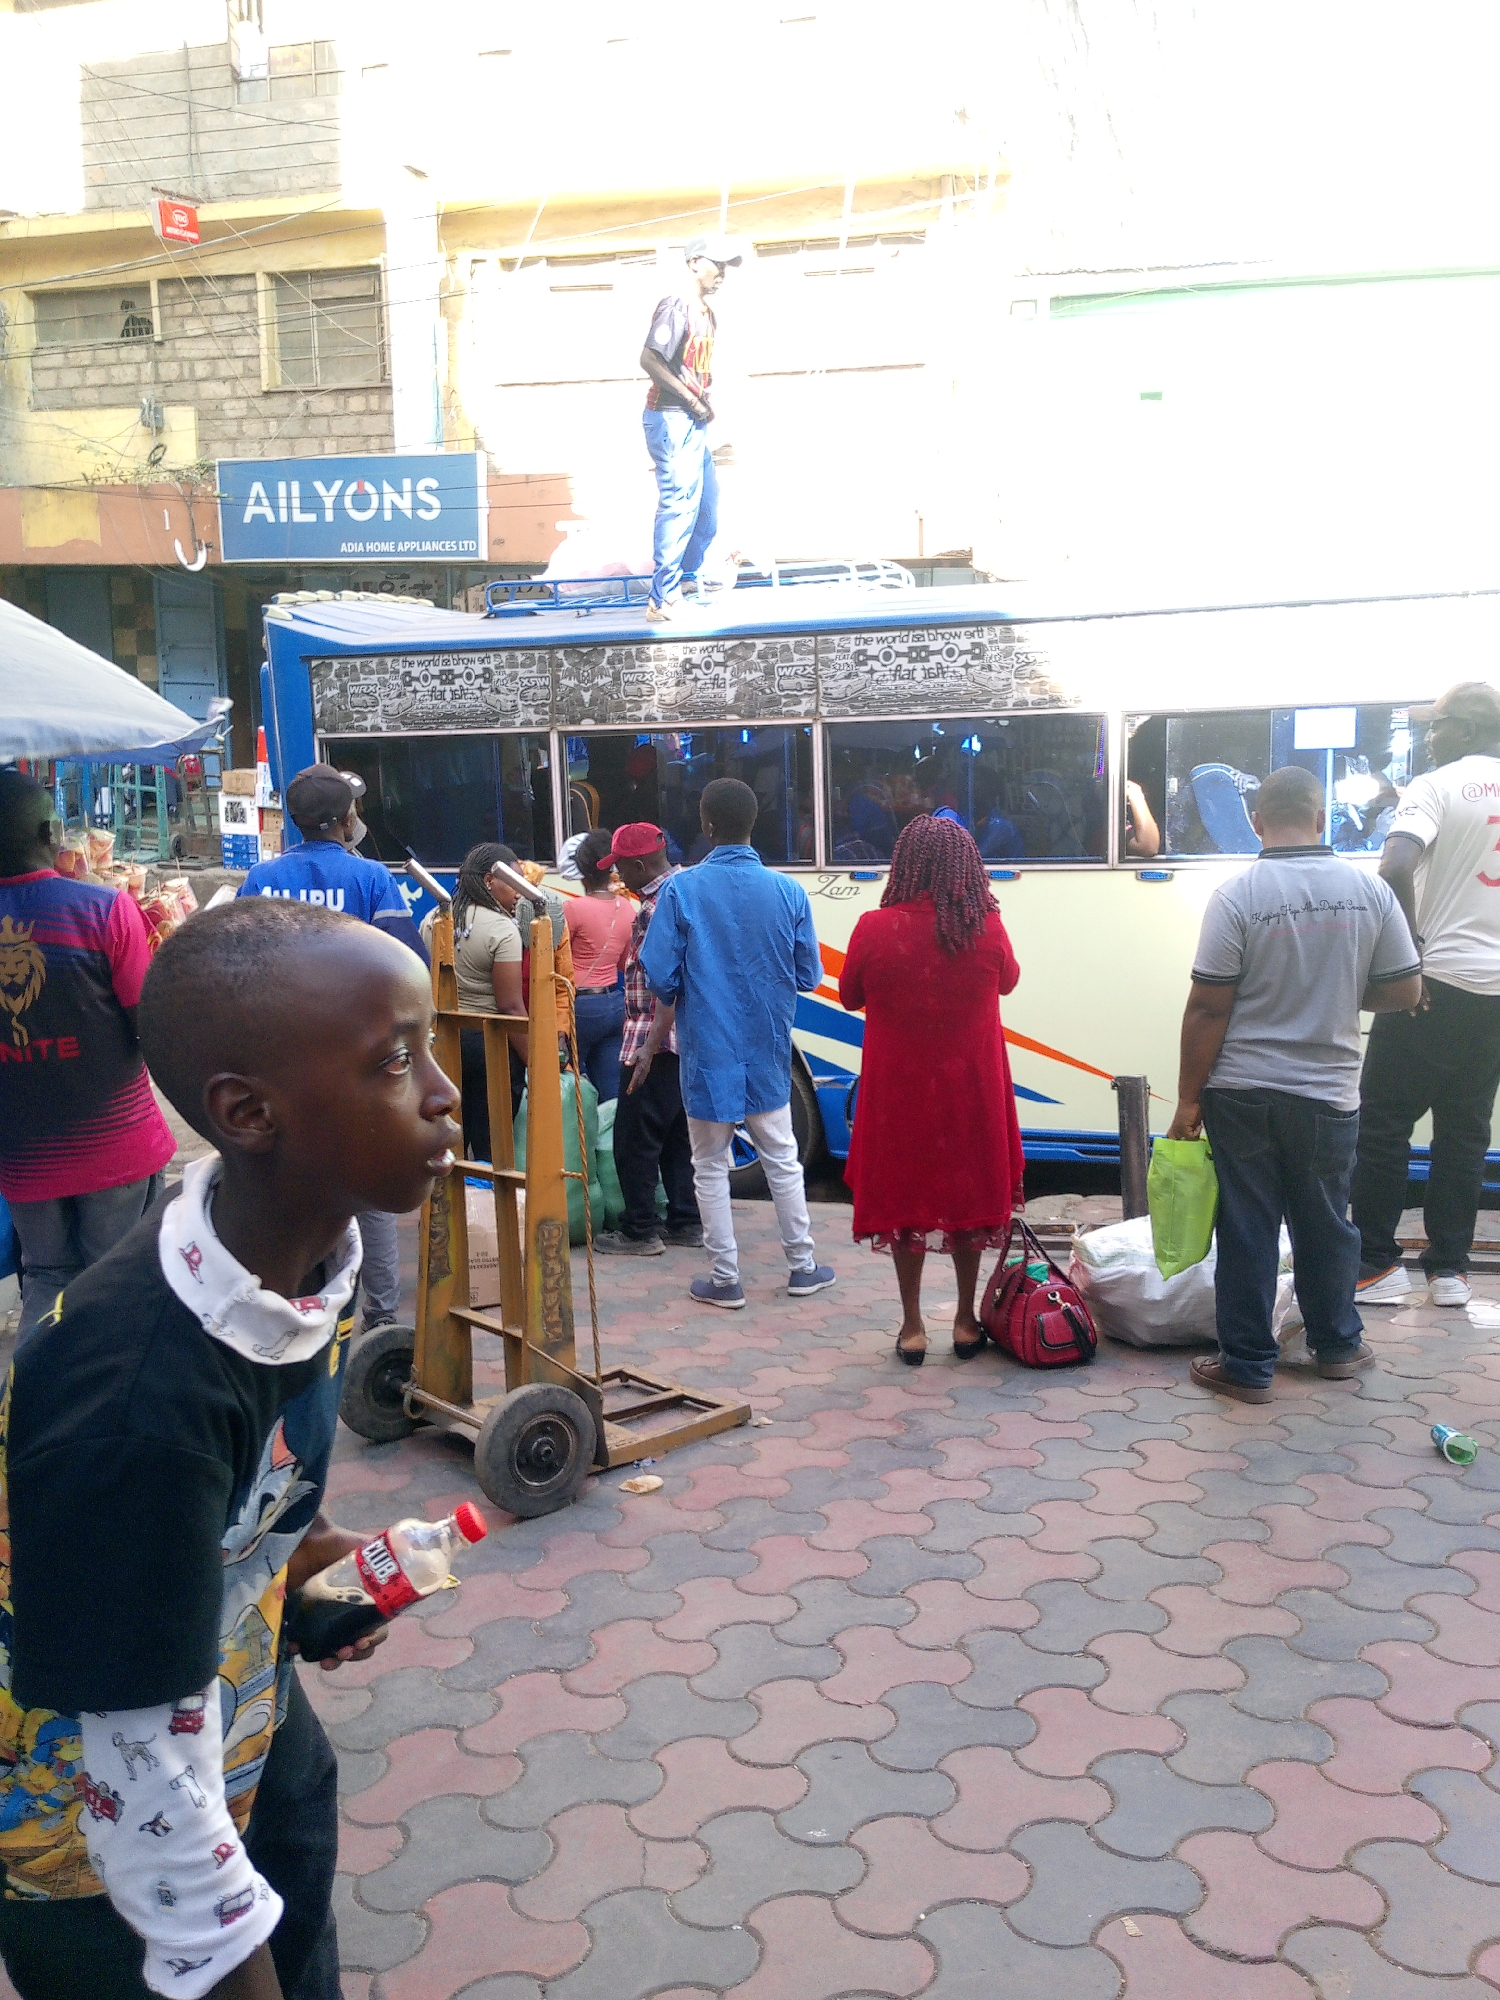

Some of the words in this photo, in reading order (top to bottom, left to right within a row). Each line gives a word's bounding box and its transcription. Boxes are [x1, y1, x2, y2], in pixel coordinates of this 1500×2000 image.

[243, 477, 442, 524] AILYONS
[340, 541, 364, 554] ADIA
[366, 541, 395, 553] HOME
[397, 540, 457, 553] APPLIANCES
[458, 540, 477, 552] LTD
[853, 635, 874, 646] the
[875, 631, 910, 645] world
[401, 657, 415, 669] the
[417, 655, 440, 668] world
[623, 672, 654, 682] WRX
[777, 665, 816, 676] WRX
[349, 684, 378, 695] WRX
[808, 874, 861, 901] Zam
[360, 1537, 401, 1580] CLUB
